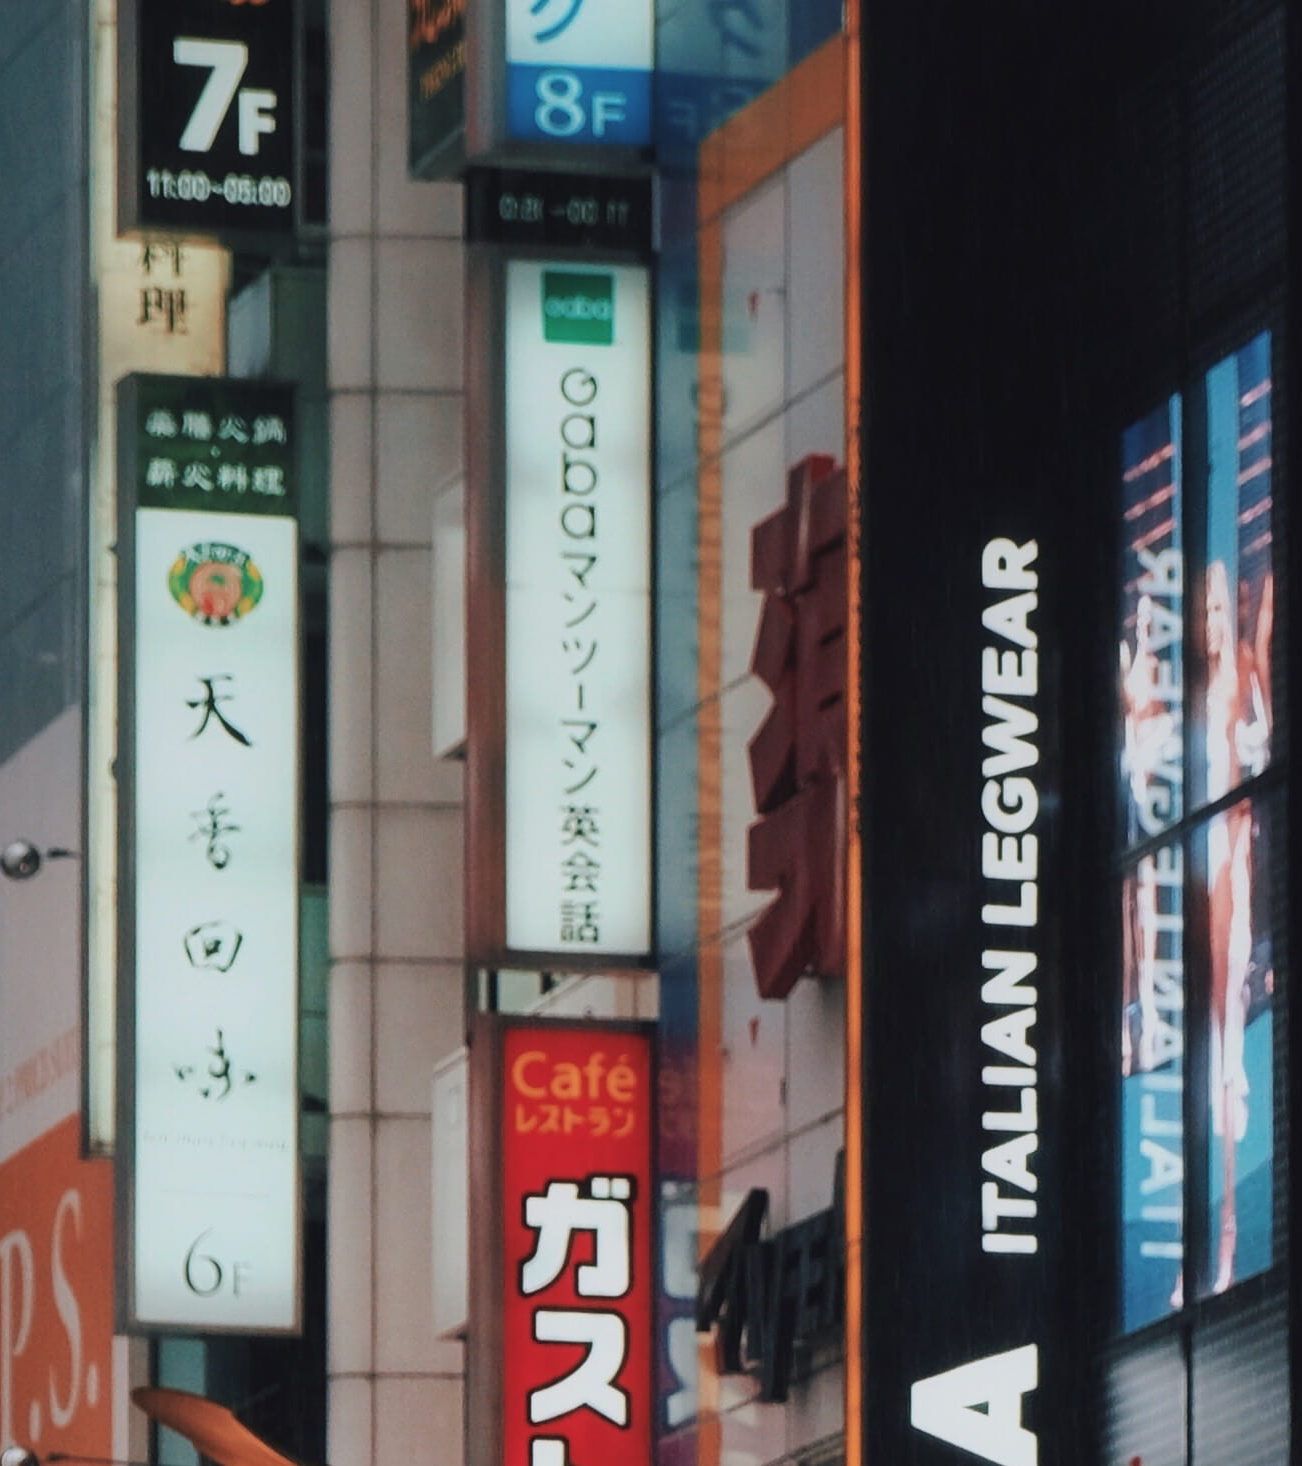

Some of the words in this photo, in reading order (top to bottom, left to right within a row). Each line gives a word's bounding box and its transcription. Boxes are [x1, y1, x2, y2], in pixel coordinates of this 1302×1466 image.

[173, 36, 277, 155] 7F
[534, 70, 627, 137] 8F
[982, 535, 1040, 928] LEGWEAR
[511, 1051, 636, 1102] Café
[515, 1103, 635, 1137] レストラン
[982, 949, 1040, 1255] ITALIAN
